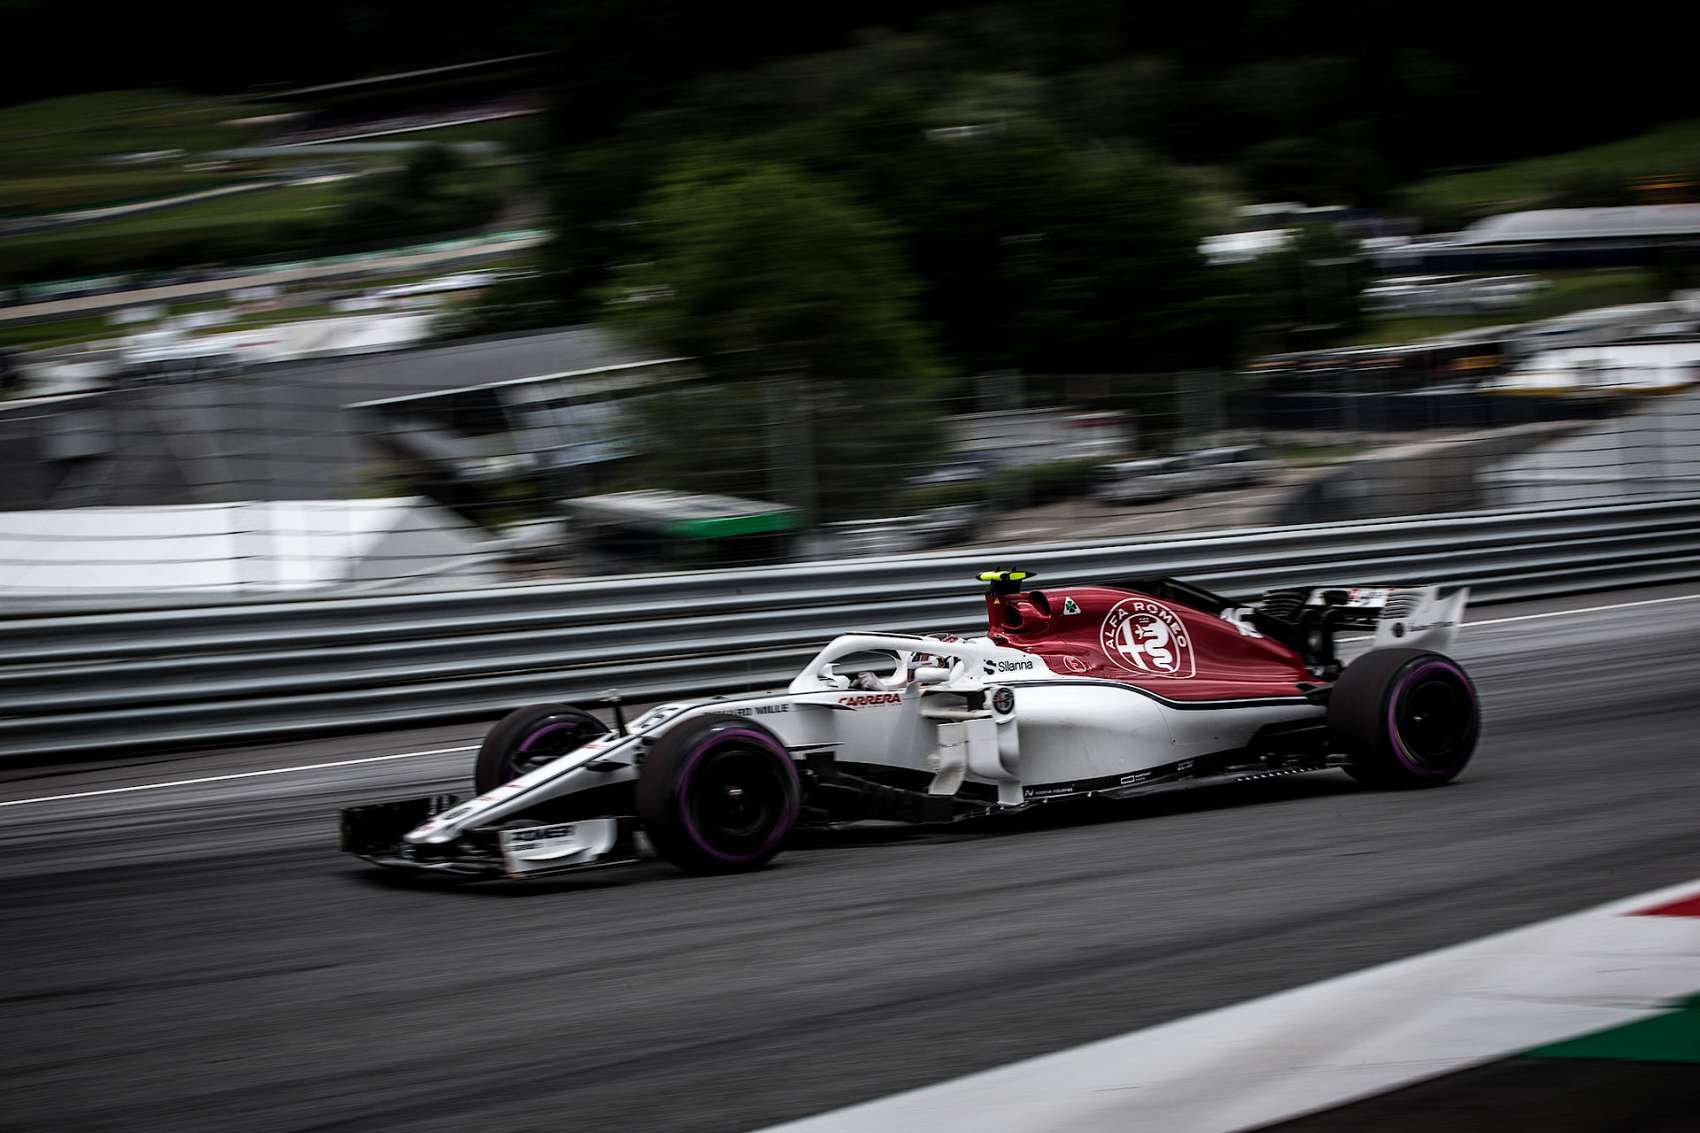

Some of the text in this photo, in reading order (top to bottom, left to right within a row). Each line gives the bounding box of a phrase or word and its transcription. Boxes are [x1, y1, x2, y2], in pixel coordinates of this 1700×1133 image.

[1105, 602, 1187, 650] ALFA ROMEO
[998, 660, 1034, 673] Silanna
[838, 693, 901, 706] CARRERA
